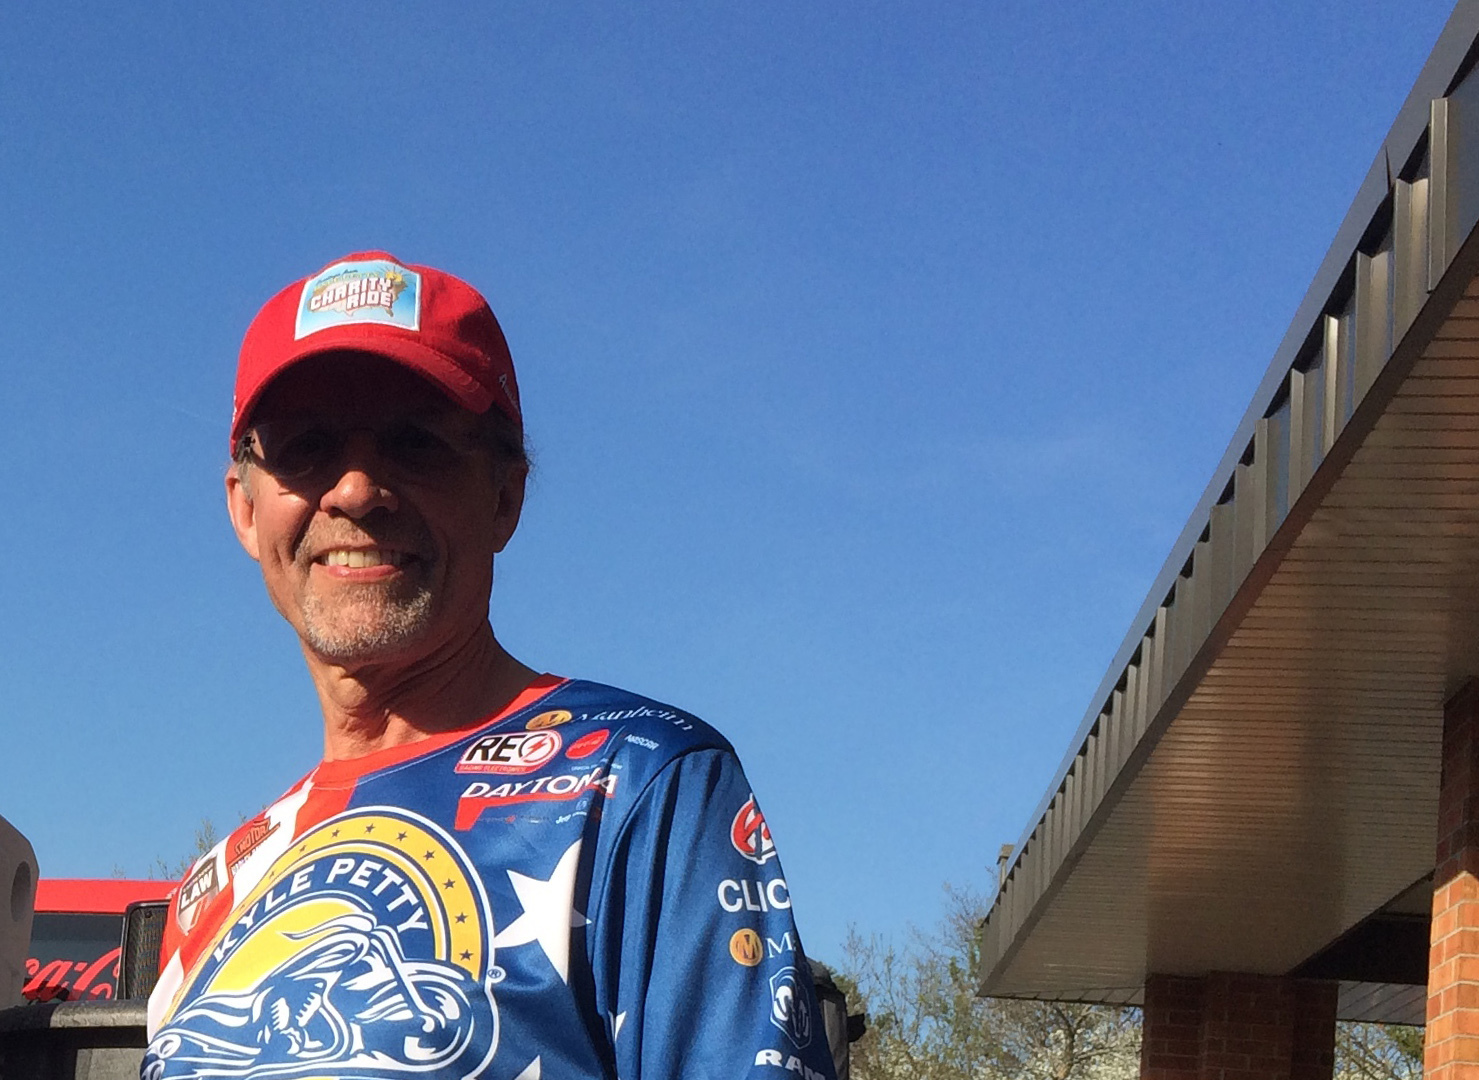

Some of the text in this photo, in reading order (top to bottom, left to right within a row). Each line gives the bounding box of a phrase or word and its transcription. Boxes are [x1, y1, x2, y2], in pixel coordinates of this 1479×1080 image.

[310, 277, 392, 311] CHARITY
[346, 290, 392, 311] RIDE
[460, 768, 618, 797] DAYTONA
[180, 868, 213, 910] LAW
[214, 858, 429, 962] KYLE PETTY
